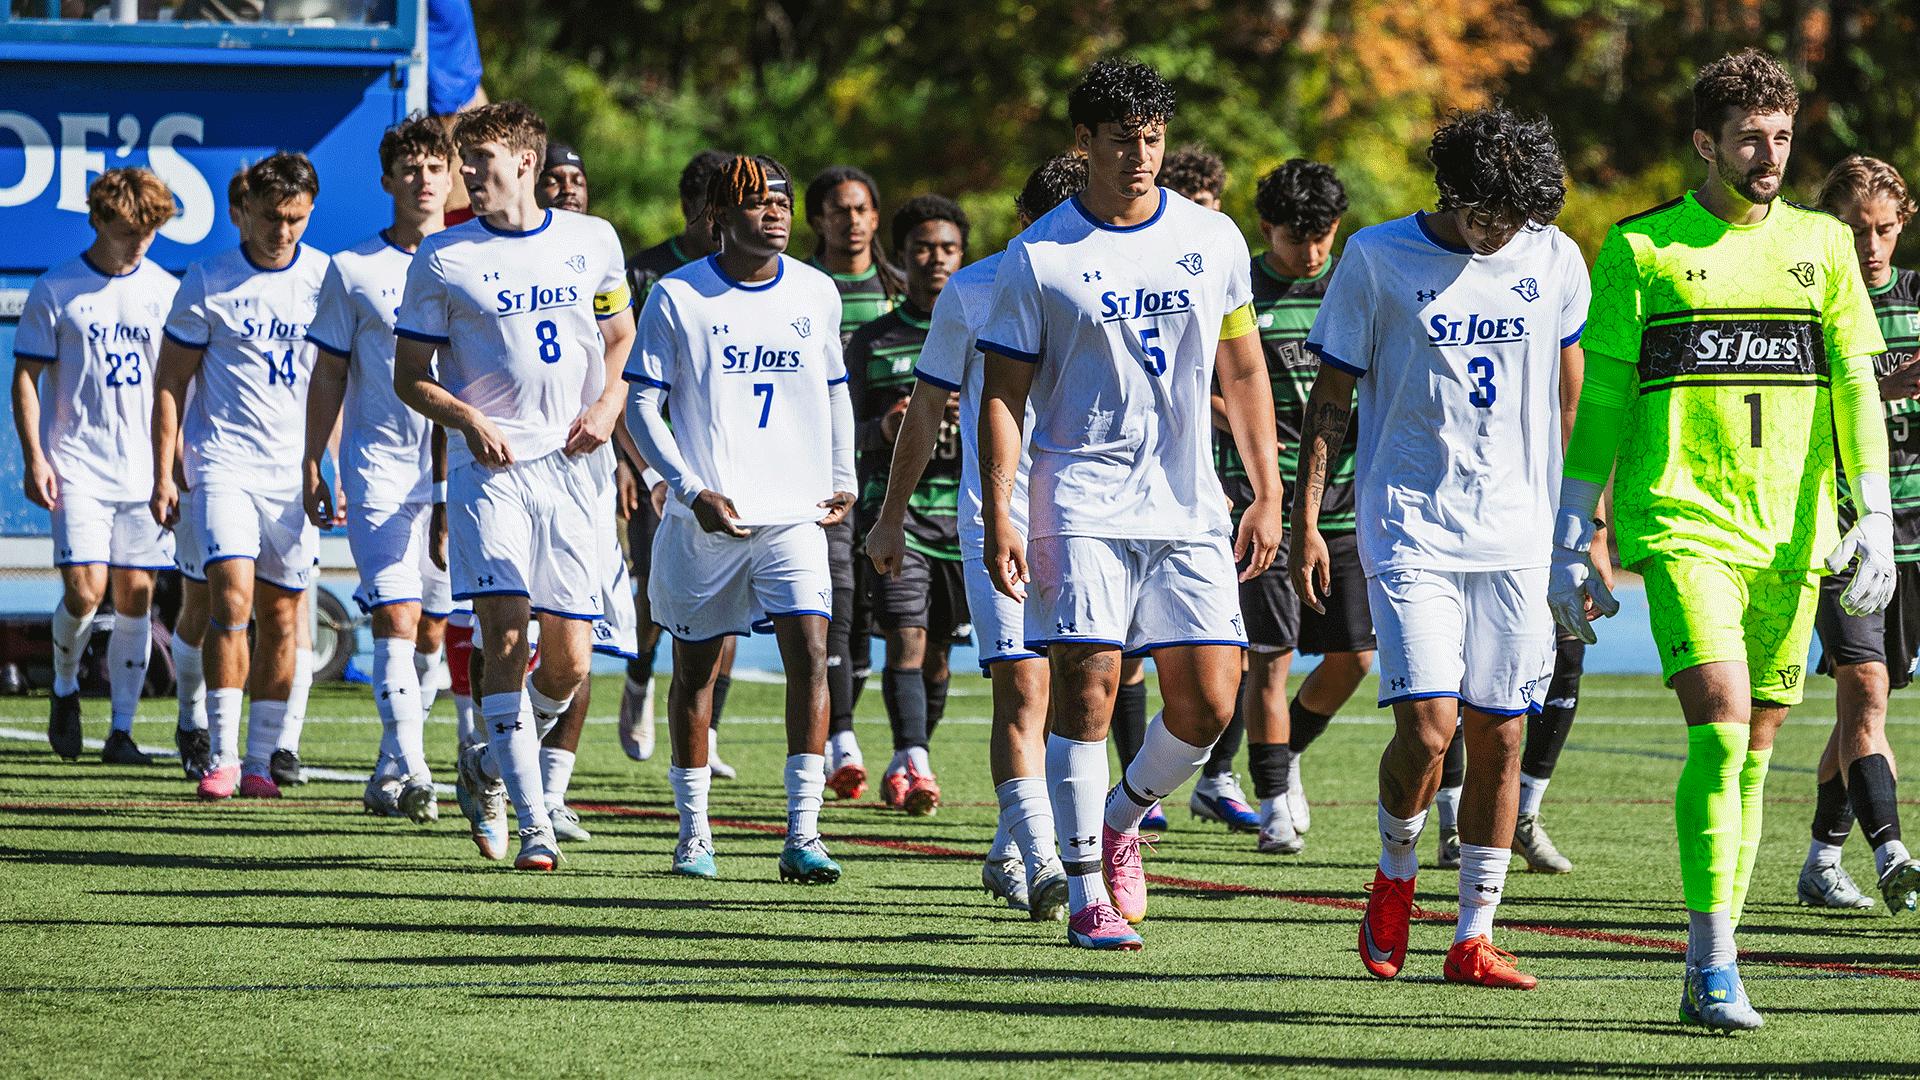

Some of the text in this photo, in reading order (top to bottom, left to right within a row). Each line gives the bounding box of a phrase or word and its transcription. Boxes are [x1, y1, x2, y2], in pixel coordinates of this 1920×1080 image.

[1130, 288, 1190, 319] JOE'S
[535, 320, 561, 364] 8
[1460, 313, 1525, 346] JOE'S
[1730, 330, 1798, 366] JOE'S
[105, 351, 141, 386] 23
[263, 349, 296, 386] 14
[748, 345, 800, 373] JOE'S
[1138, 327, 1167, 377] 5
[1467, 356, 1497, 408] 3
[753, 383, 774, 428] 7
[1744, 393, 1763, 448] 1
